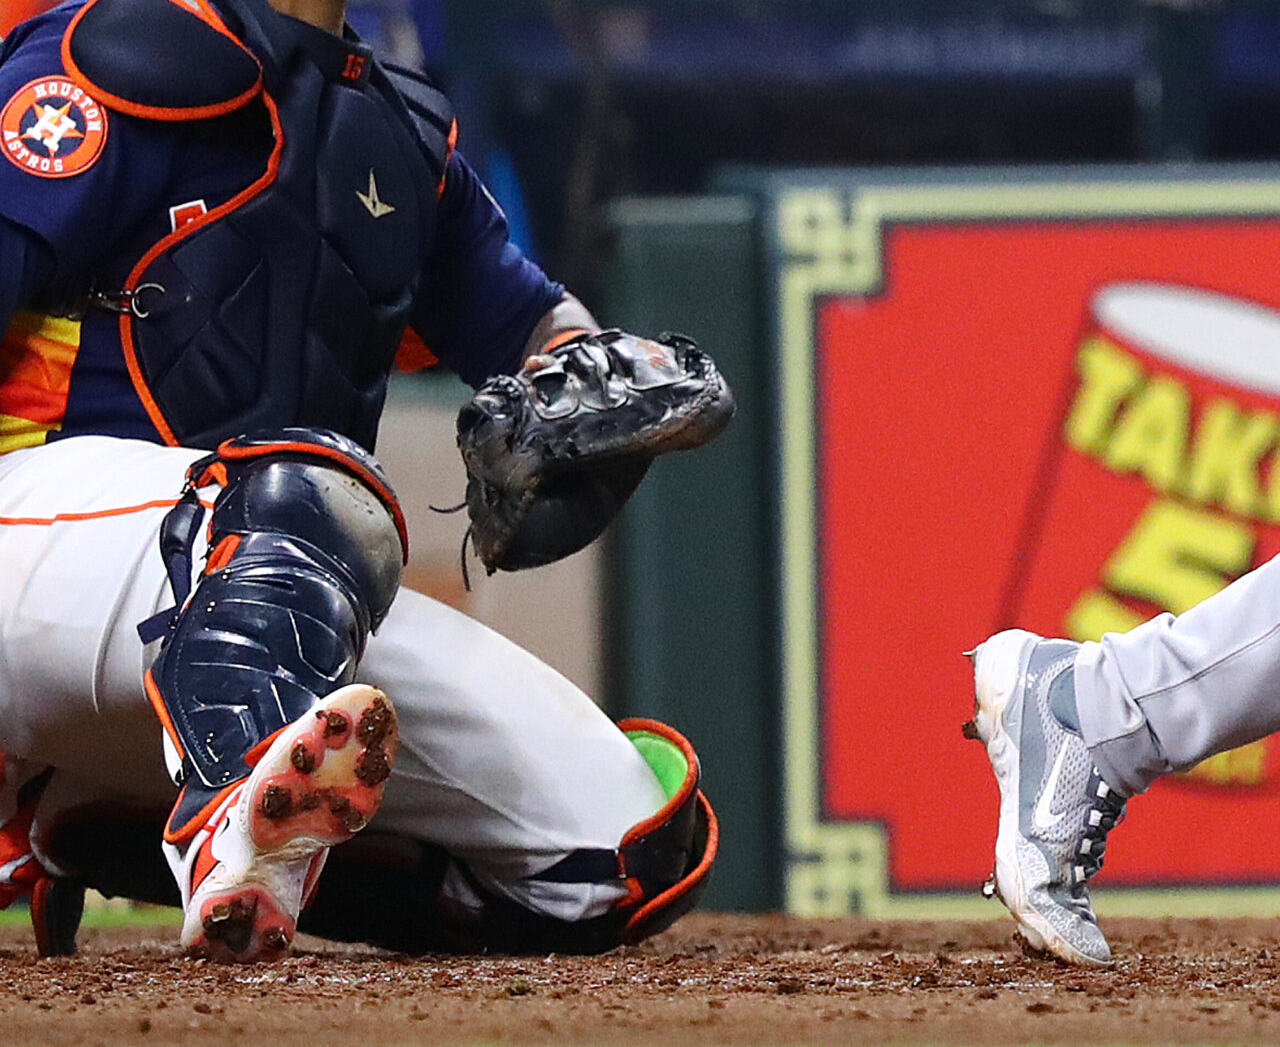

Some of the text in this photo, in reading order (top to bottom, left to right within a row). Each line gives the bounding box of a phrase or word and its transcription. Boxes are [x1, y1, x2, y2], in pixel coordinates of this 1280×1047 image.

[33, 81, 103, 132] HOUSTON
[3, 129, 64, 172] ASTROS
[1066, 499, 1258, 642] 5
